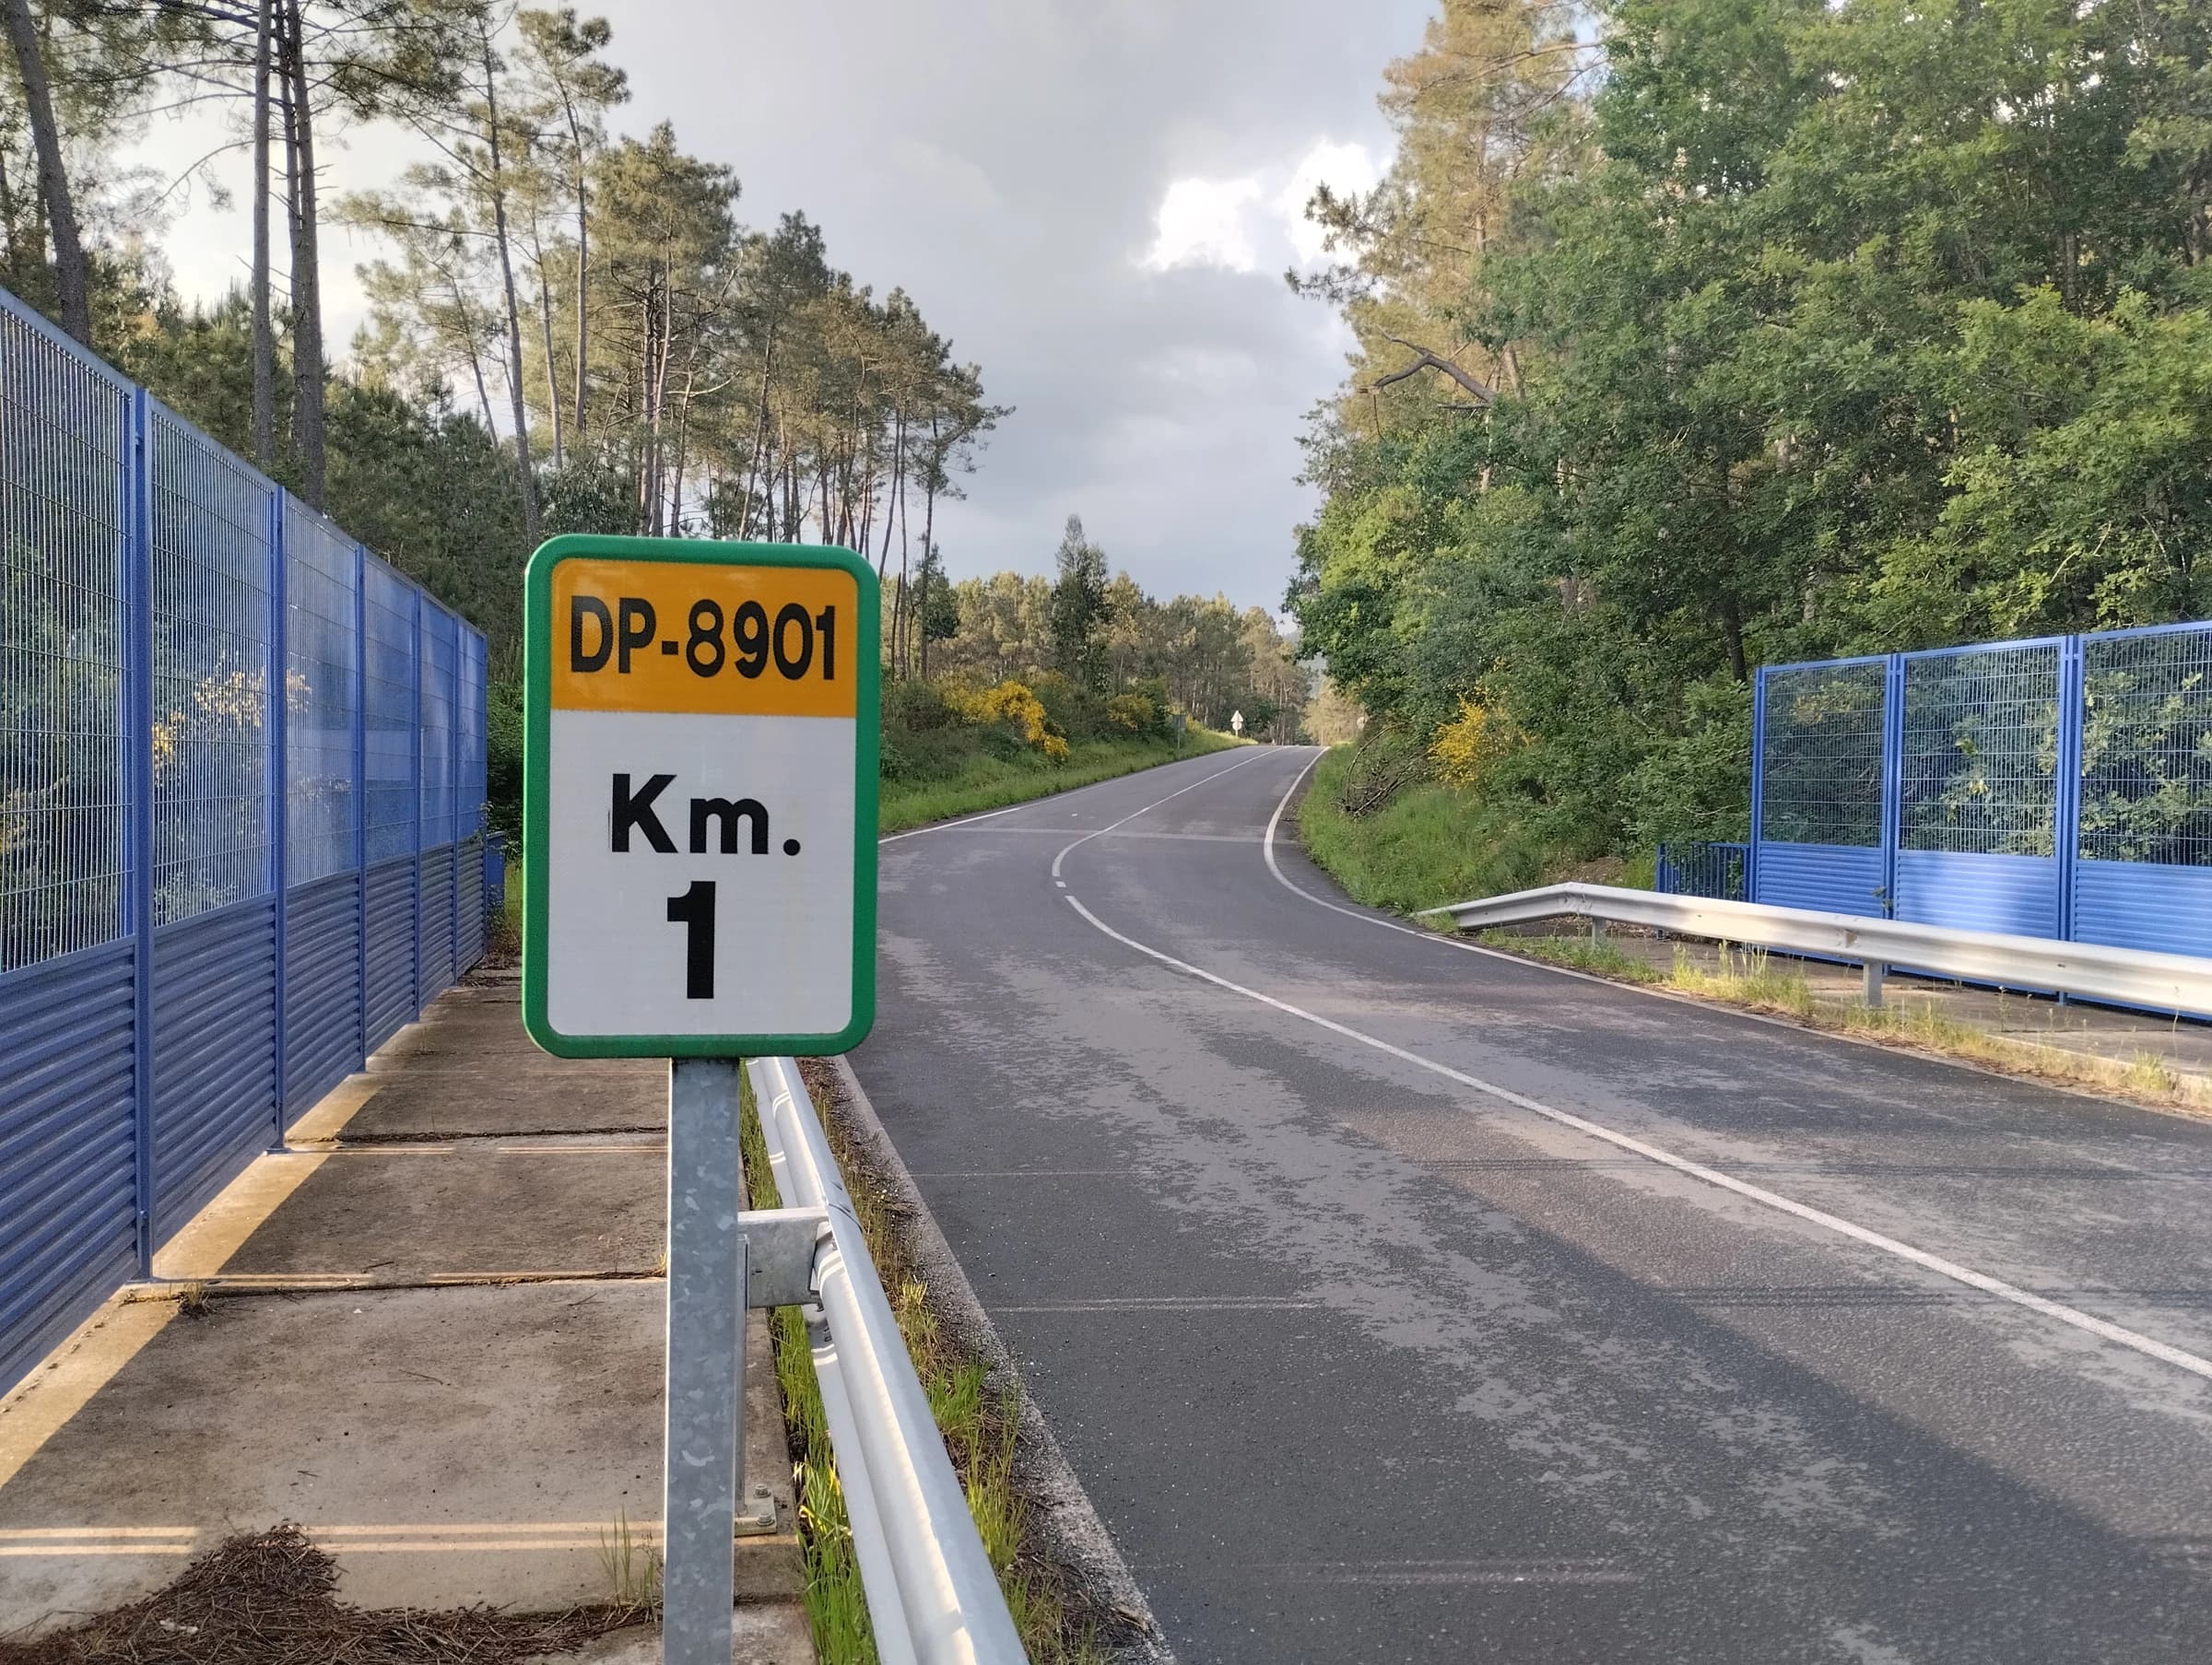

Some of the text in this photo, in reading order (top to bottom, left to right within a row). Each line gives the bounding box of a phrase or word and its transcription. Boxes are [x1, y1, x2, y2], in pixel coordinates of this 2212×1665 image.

[571, 595, 836, 681] DP-8901
[610, 773, 801, 857] Km.
[666, 880, 716, 1000] 1
